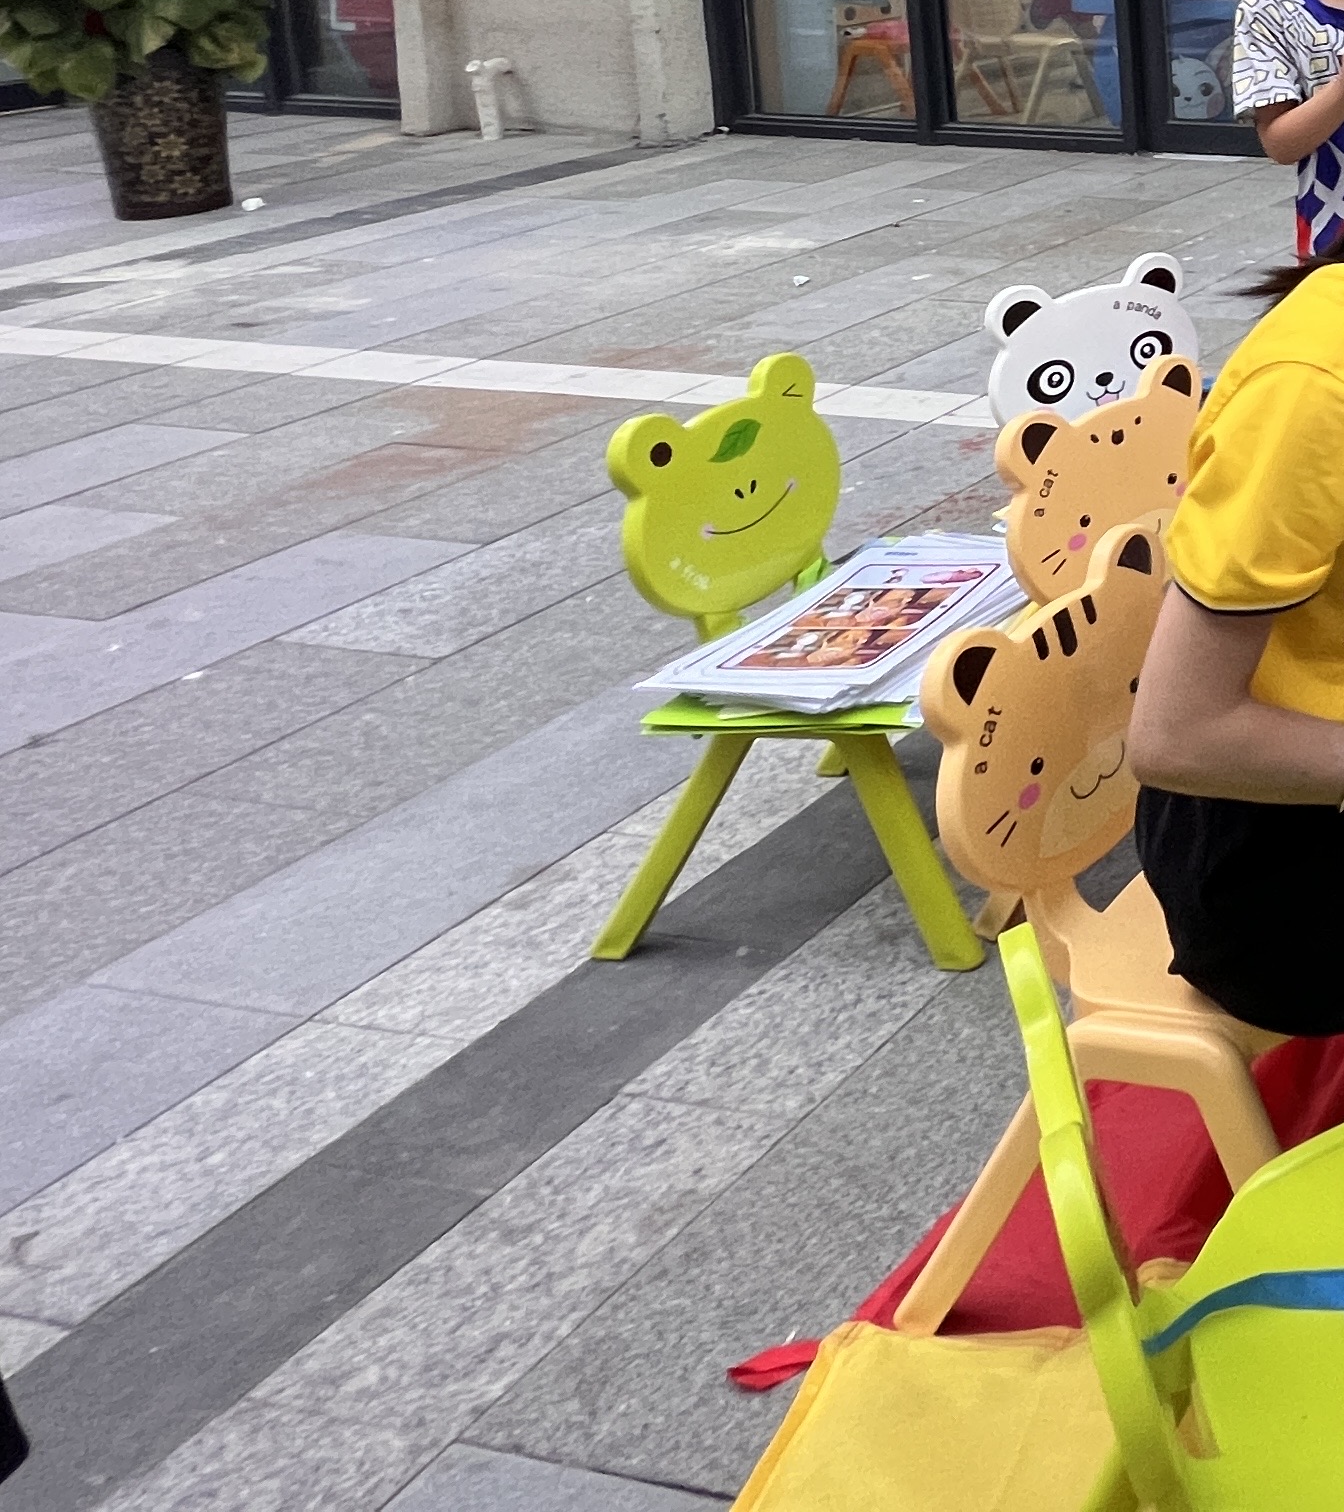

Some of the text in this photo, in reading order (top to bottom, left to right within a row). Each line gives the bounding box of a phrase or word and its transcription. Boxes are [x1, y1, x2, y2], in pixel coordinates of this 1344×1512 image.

[1126, 301, 1162, 320] panda
[1039, 469, 1059, 498] cat
[979, 705, 1003, 748] cat
